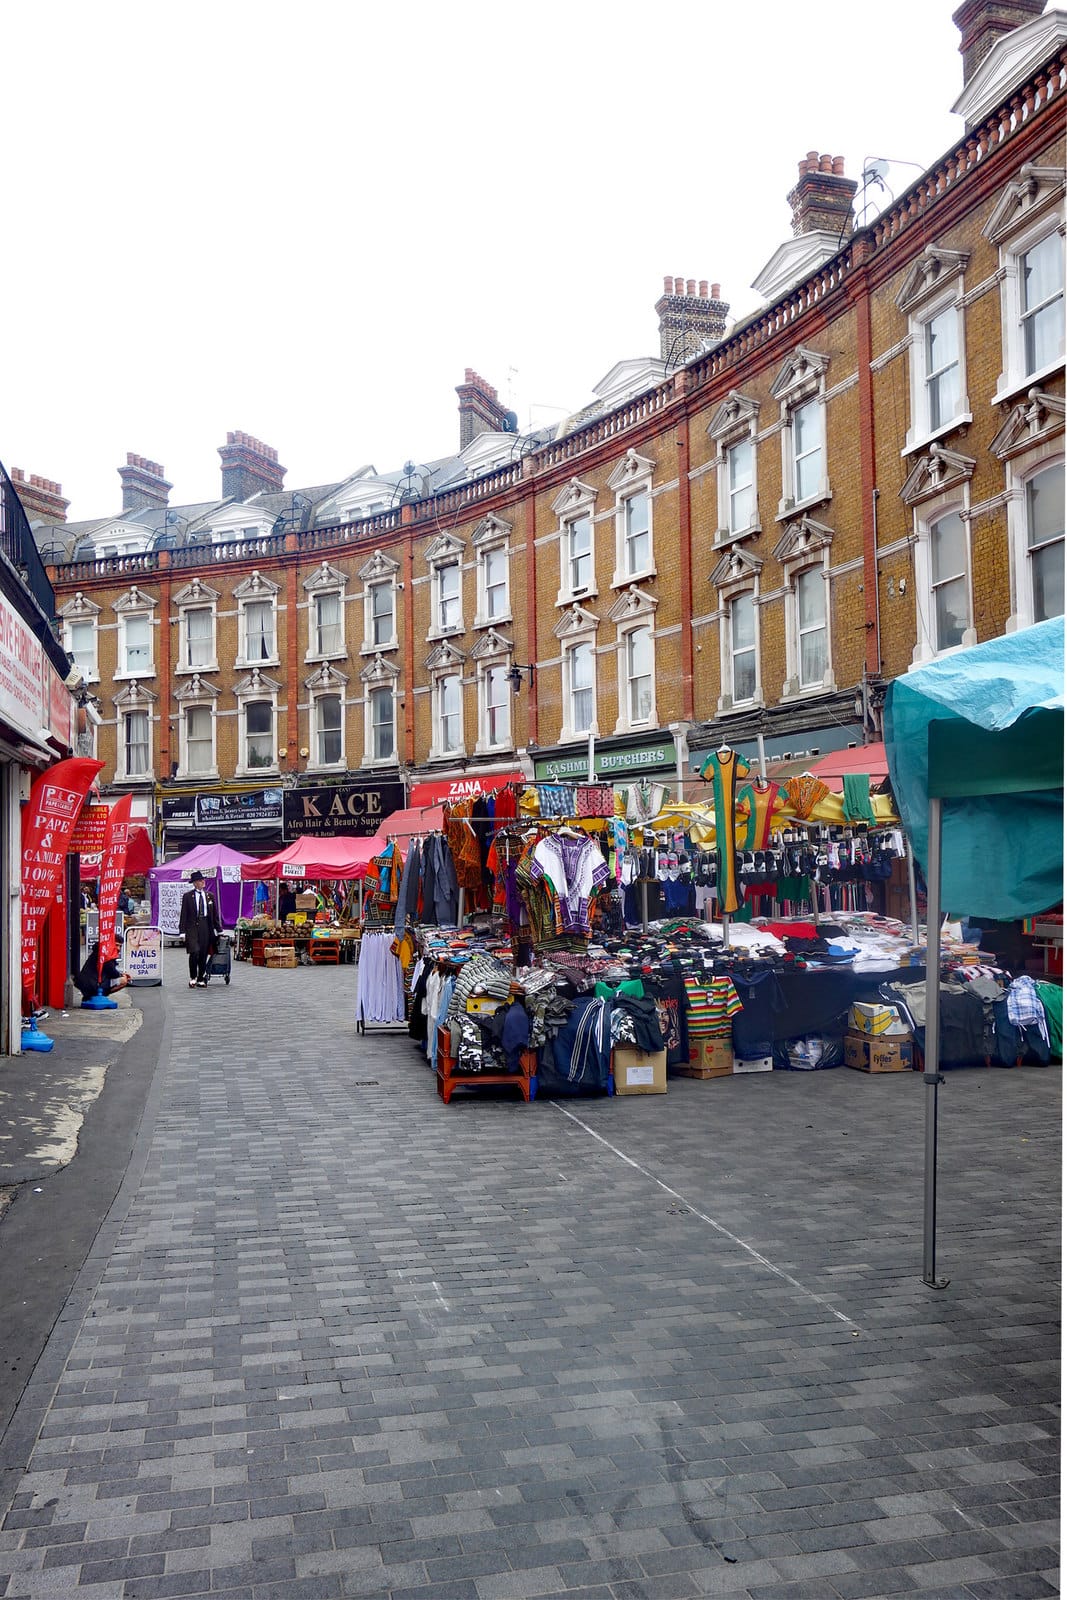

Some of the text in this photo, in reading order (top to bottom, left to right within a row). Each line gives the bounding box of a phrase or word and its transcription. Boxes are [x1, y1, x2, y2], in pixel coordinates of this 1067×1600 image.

[546, 749, 665, 775] KASHMI BUTCHERS
[449, 780, 482, 795] ZANA
[46, 788, 56, 798] P
[67, 793, 76, 803] C
[222, 796, 231, 806] K
[301, 792, 382, 817] K ACE
[34, 815, 70, 833] PAPE
[288, 816, 383, 829] Afro Hair & Beauty Super
[41, 832, 53, 848] &
[24, 866, 55, 882] 100%
[131, 949, 157, 958] NAILS
